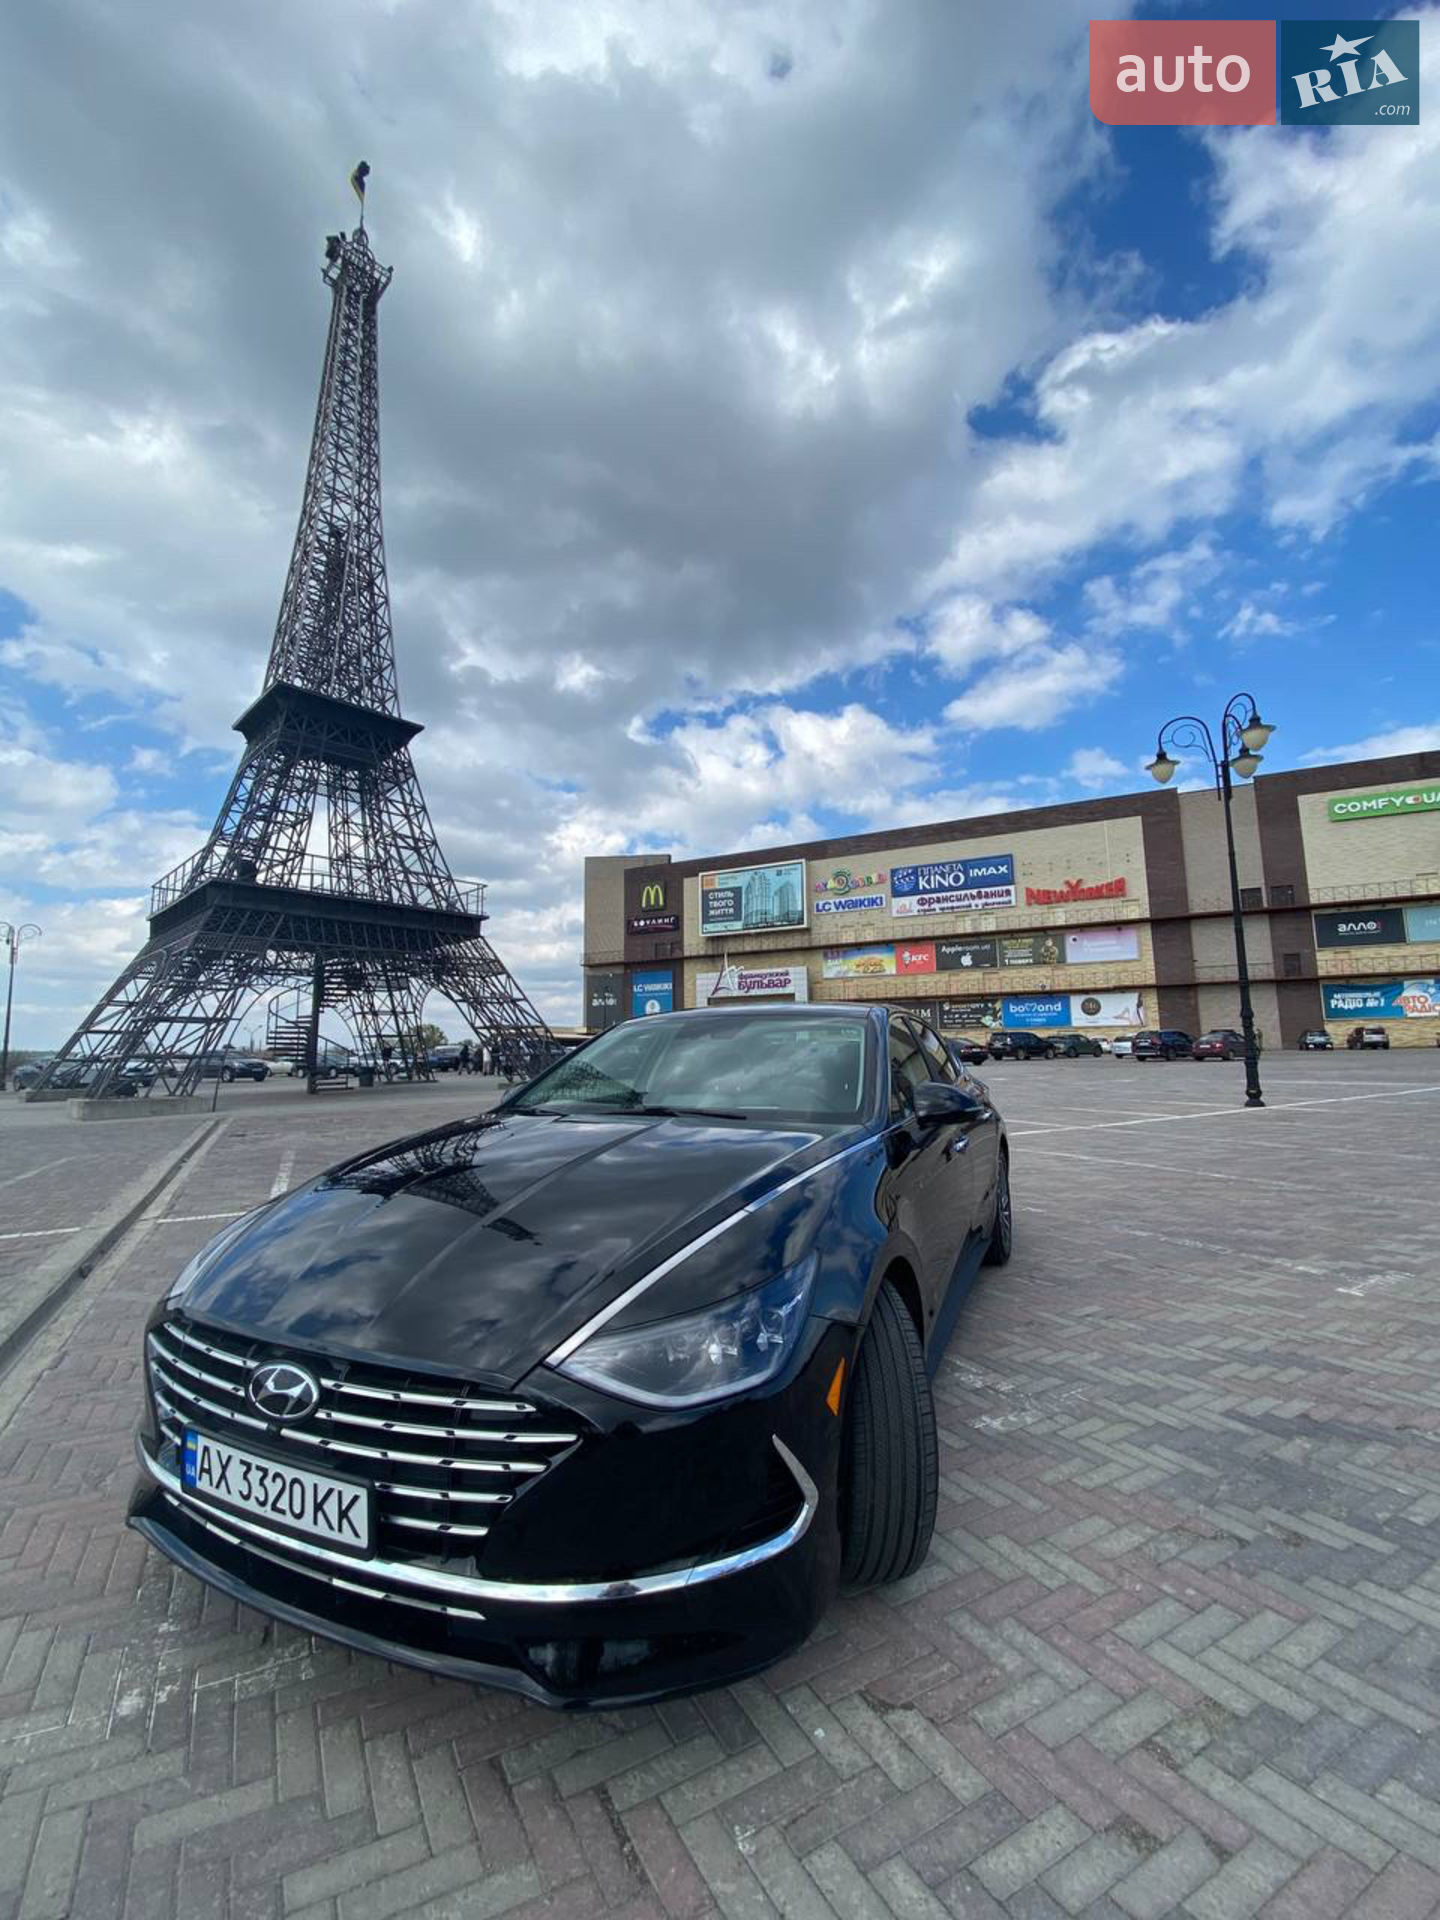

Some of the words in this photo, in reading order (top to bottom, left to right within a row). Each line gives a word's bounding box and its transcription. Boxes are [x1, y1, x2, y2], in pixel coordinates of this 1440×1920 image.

[969, 864, 1009, 878] IMAX
[918, 871, 965, 891] KINO
[708, 890, 735, 900] СТИЛЬ
[708, 899, 735, 909] ТВОГО
[815, 901, 832, 913] LC
[707, 907, 735, 917] ЖИТТЯ
[911, 953, 930, 962] KFC
[1330, 998, 1364, 1010] РАДІО
[185, 1463, 196, 1478] UA
[238, 1458, 305, 1521] 3320
[312, 1482, 361, 1540] KK
